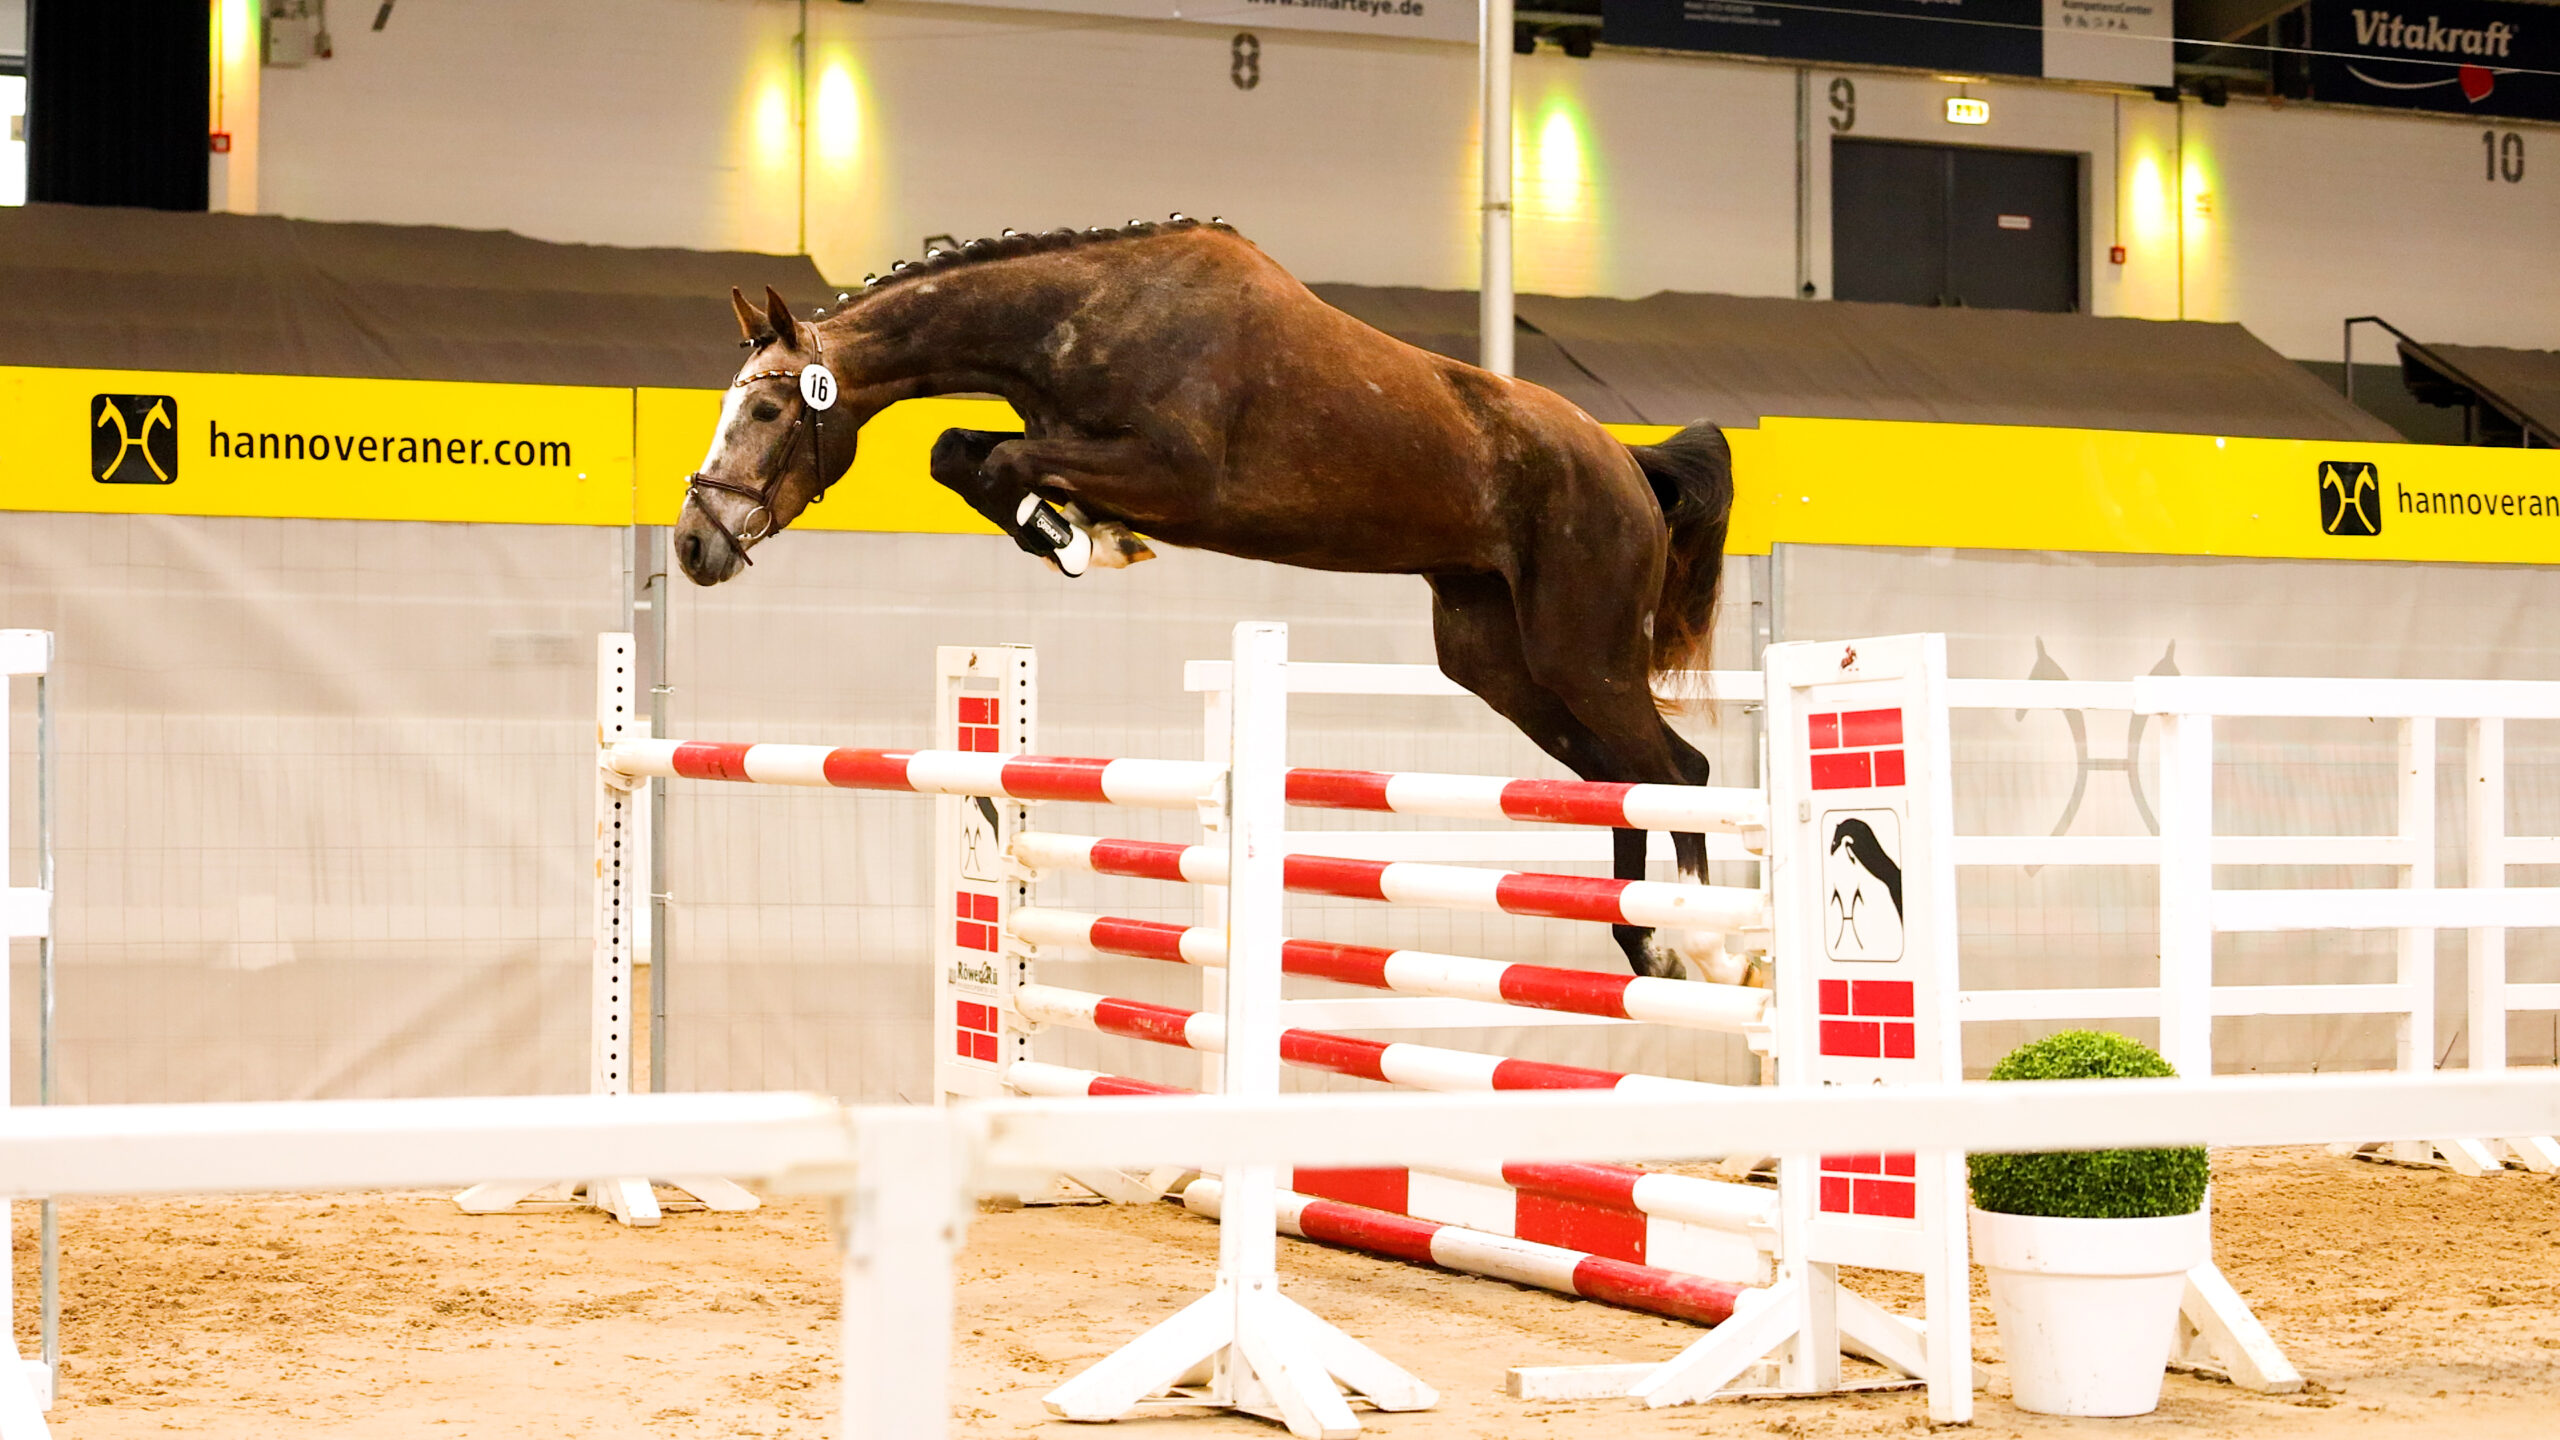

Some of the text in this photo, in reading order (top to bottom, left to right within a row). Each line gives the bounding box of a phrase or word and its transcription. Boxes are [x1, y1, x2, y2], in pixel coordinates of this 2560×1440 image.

[1247, 0, 1424, 17] .smarteye.de
[2351, 9, 2513, 58] Vitakraft
[1231, 32, 1261, 90] 8
[1828, 77, 1856, 132] 9
[2482, 130, 2525, 184] 10
[811, 373, 828, 402] 16
[209, 420, 572, 467] hannoveraner.com
[2398, 482, 2560, 517] hannoveran
